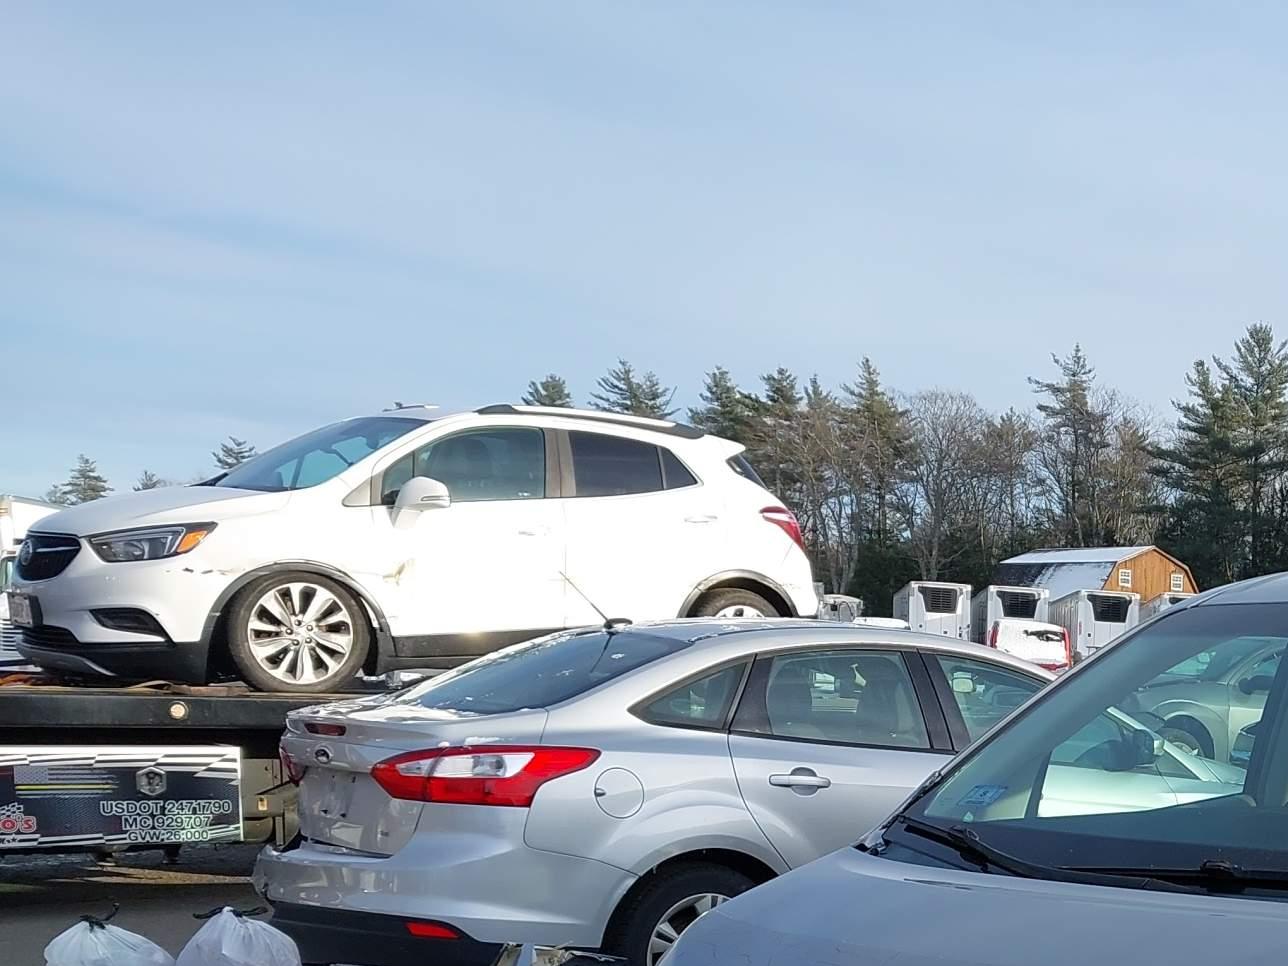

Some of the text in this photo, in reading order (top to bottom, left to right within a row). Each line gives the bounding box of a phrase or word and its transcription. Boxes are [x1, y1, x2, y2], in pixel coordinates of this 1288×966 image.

[100, 800, 232, 815] USDOT 2471790
[122, 815, 213, 830] MC 929707
